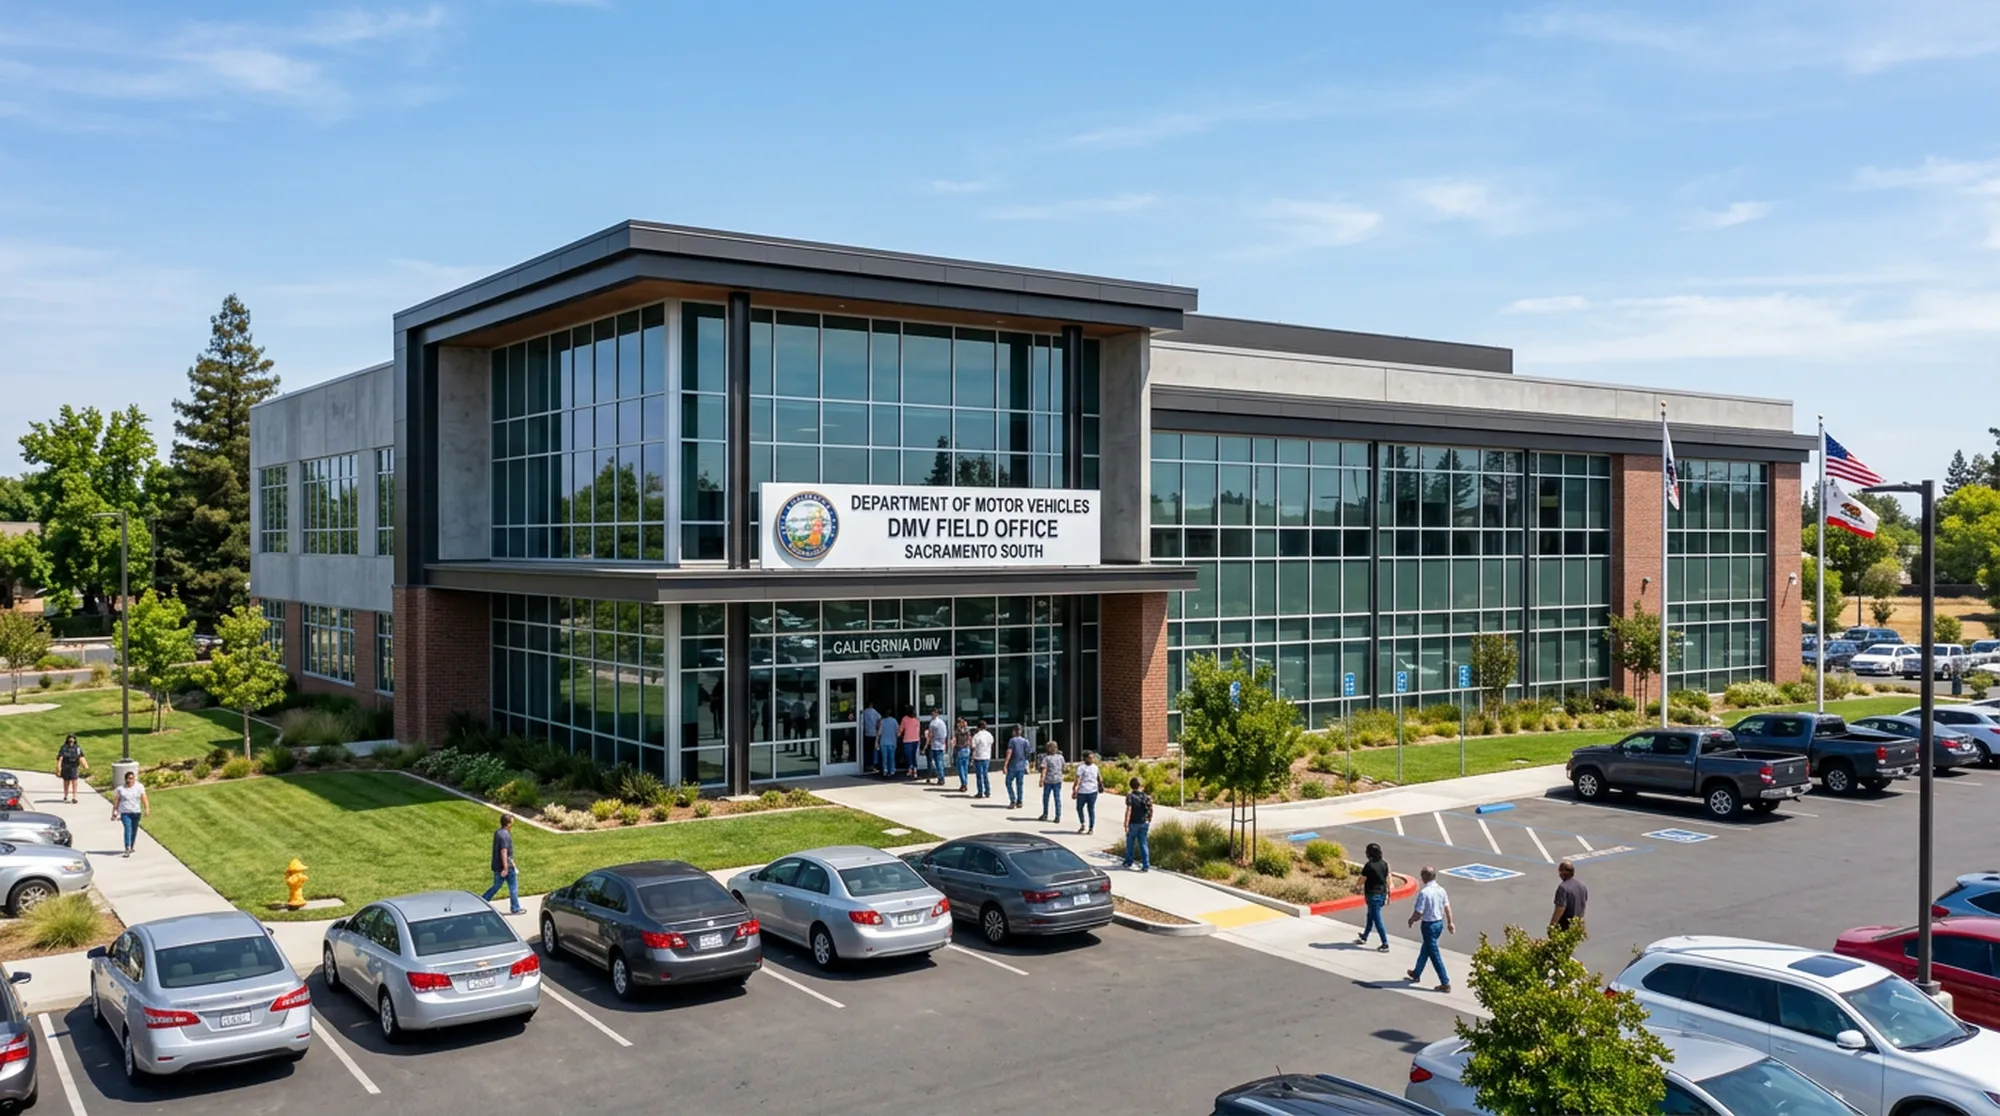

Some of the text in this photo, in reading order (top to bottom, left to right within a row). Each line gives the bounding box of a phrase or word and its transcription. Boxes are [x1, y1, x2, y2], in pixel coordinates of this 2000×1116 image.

[851, 494, 1090, 514] DEPARTMENT OF MOTOR VEHICLES
[888, 517, 1059, 539] DMV FIELD OFFICE
[904, 543, 1044, 559] SACRAMENTO SOUTH
